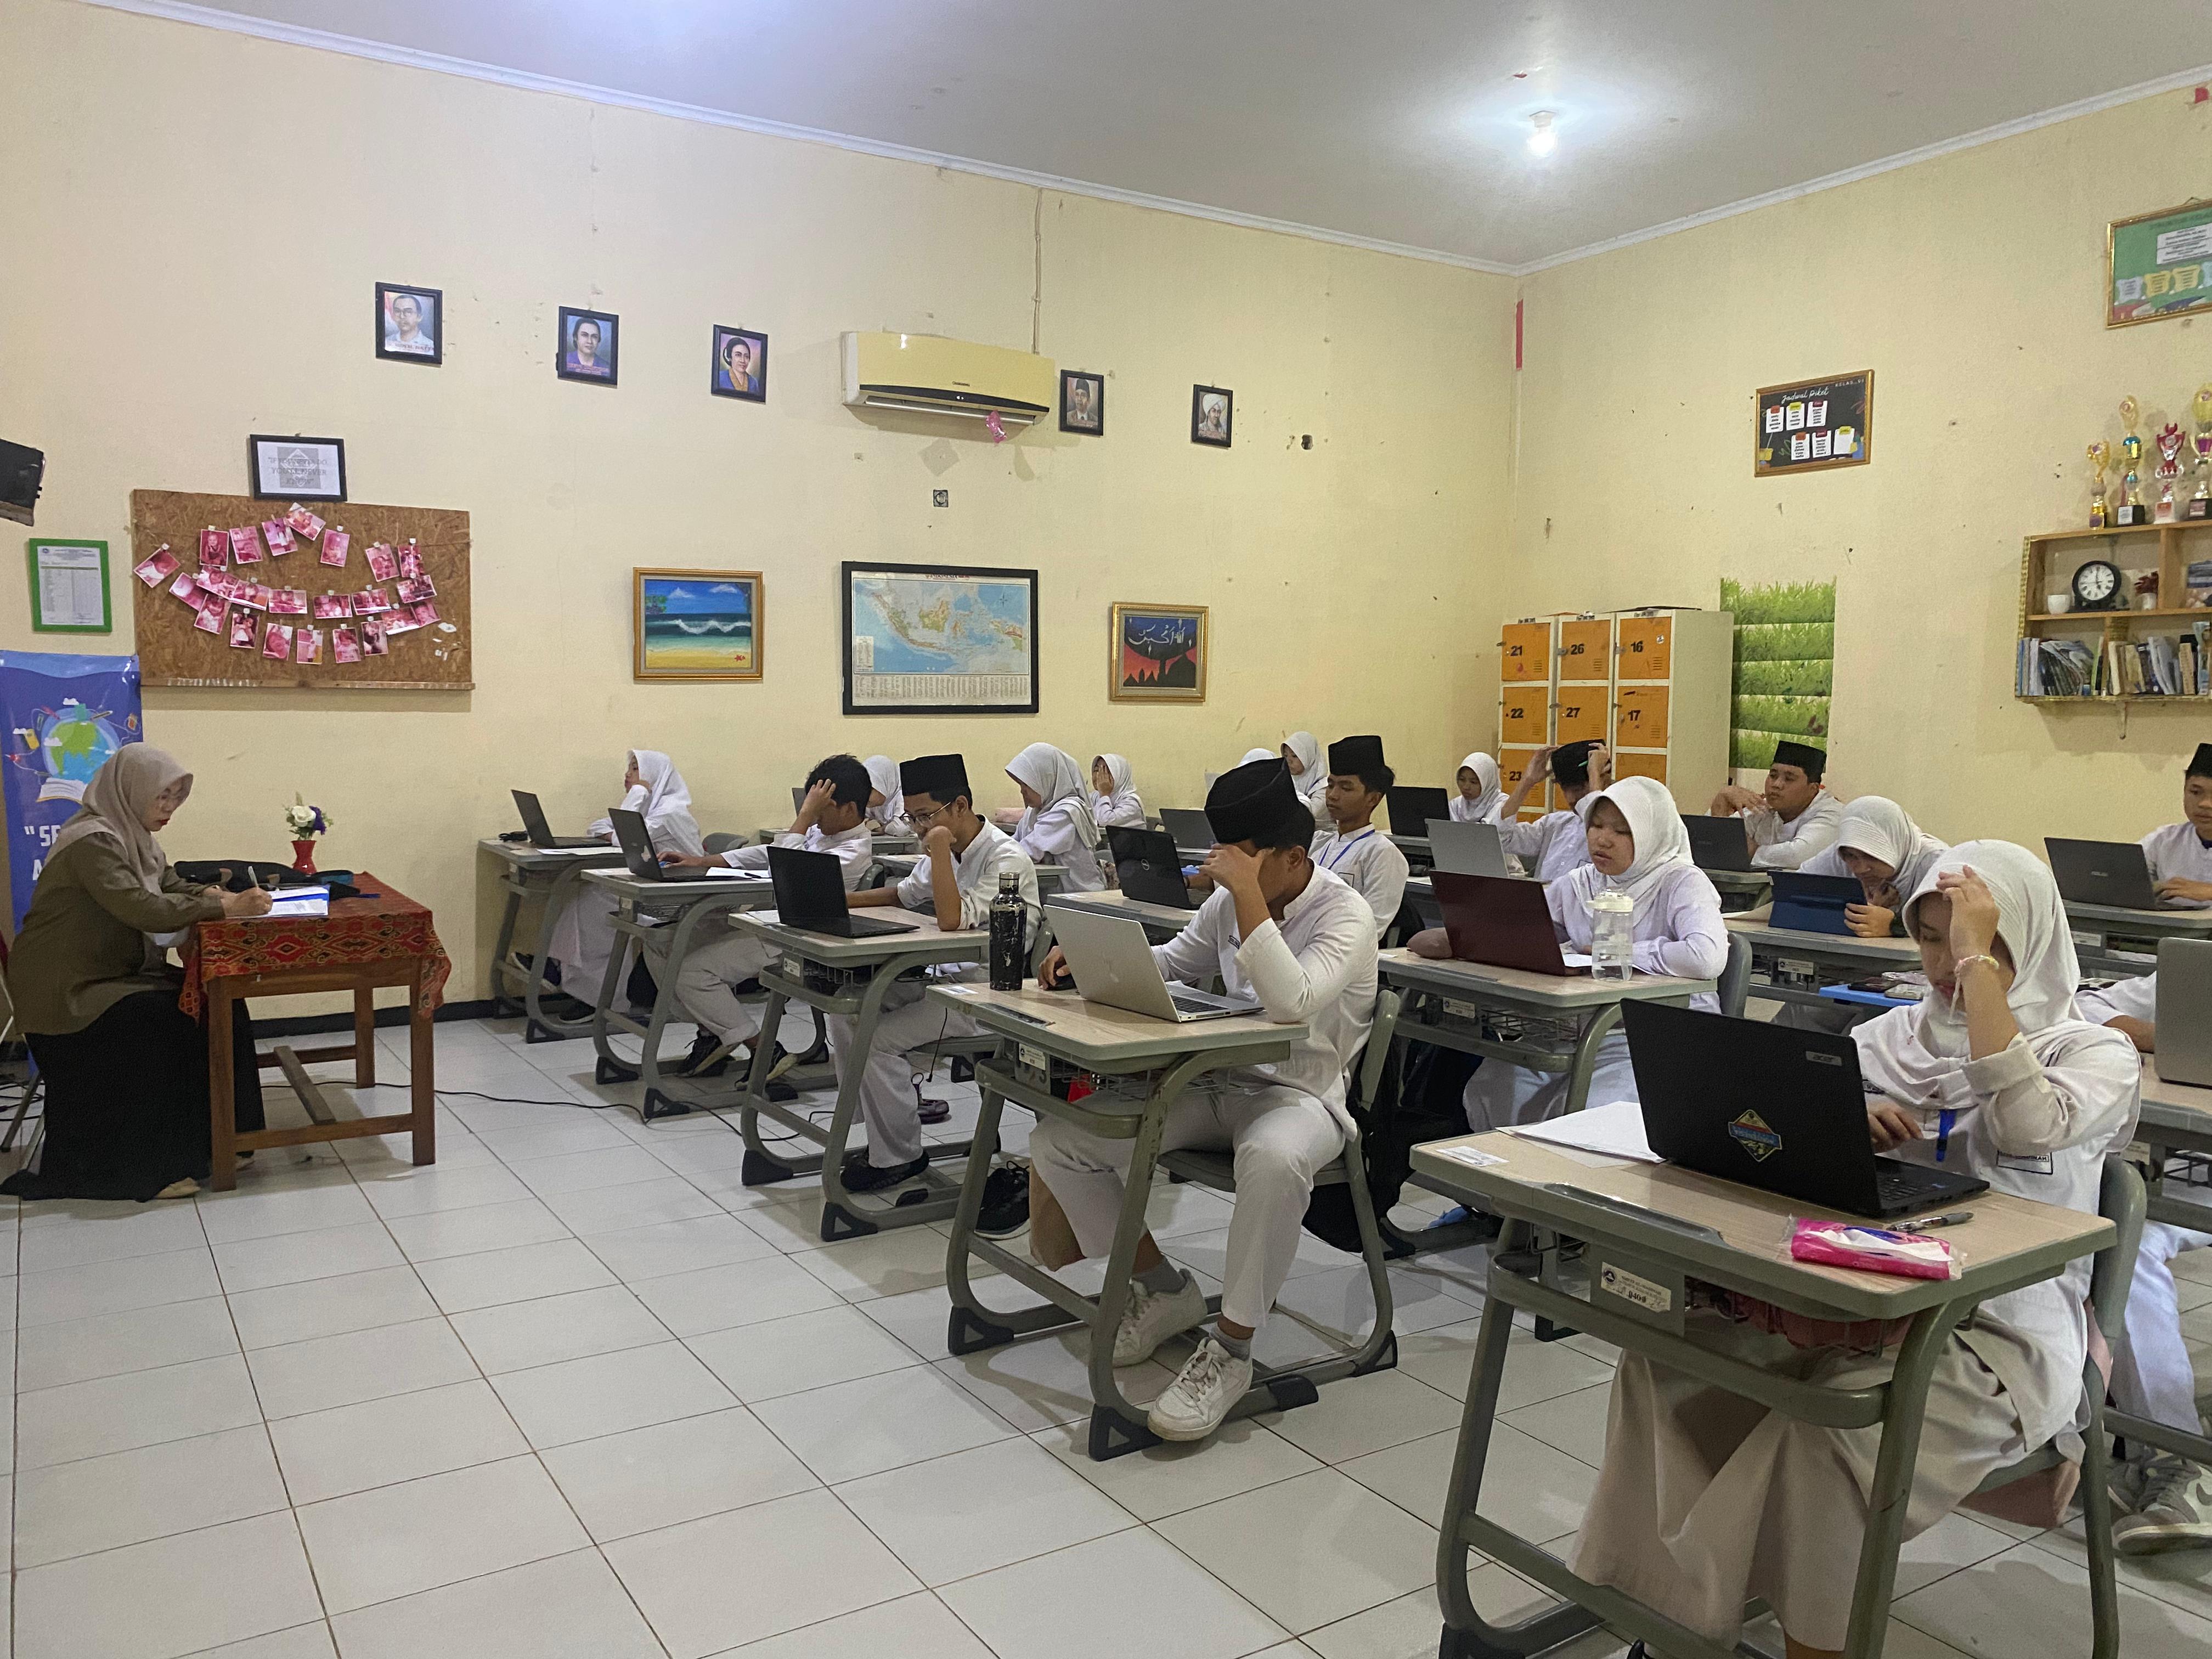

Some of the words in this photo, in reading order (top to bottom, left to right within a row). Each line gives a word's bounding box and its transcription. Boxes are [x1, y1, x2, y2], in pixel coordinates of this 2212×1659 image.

[1510, 646, 1522, 656] 21
[1571, 644, 1584, 655] 26
[1631, 641, 1643, 653] 16
[1510, 708, 1523, 719] 22
[1566, 707, 1581, 718] 27
[1628, 710, 1641, 721] 17
[1509, 771, 1522, 781] 23
[1813, 1054, 1833, 1063] acer
